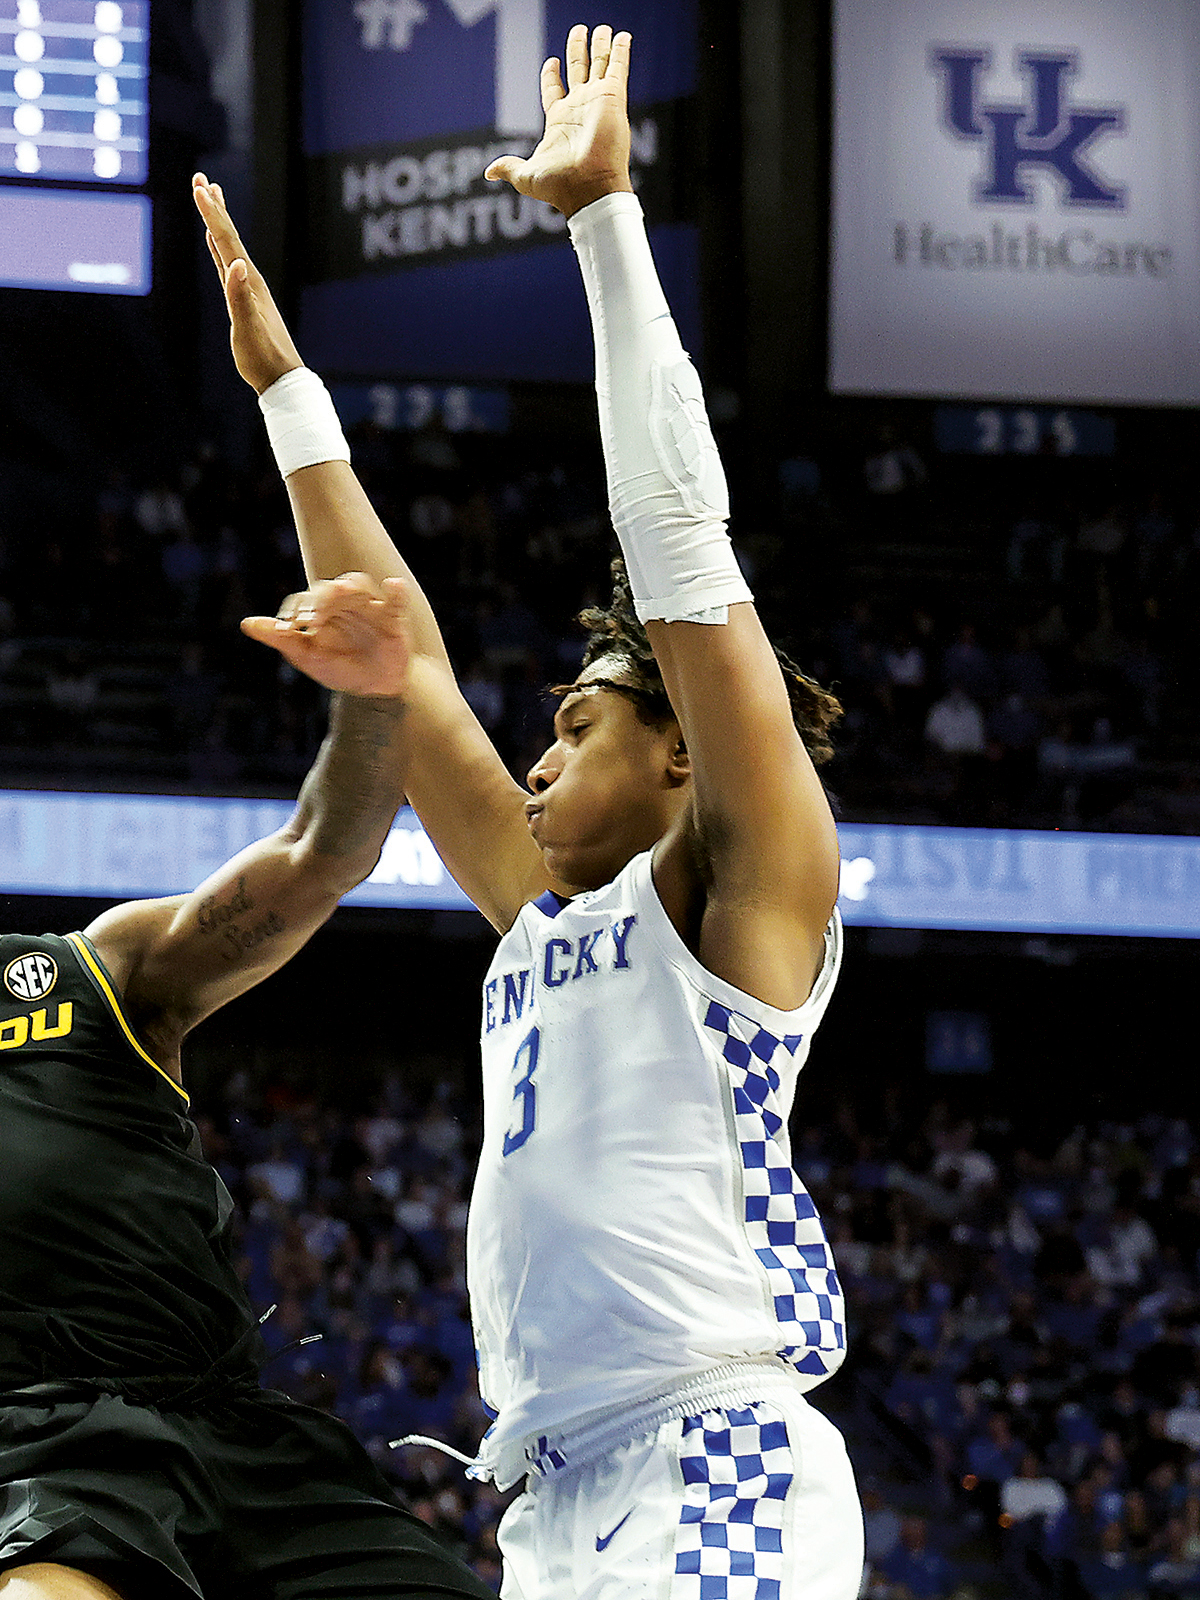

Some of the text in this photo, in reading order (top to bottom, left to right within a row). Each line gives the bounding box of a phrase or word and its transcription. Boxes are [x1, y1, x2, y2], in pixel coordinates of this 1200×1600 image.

[931, 44, 1126, 208] UK
[363, 195, 568, 260] KENTUC
[894, 222, 1172, 278] HealthCare
[7, 954, 55, 999] SEC
[502, 1026, 540, 1157] 3
